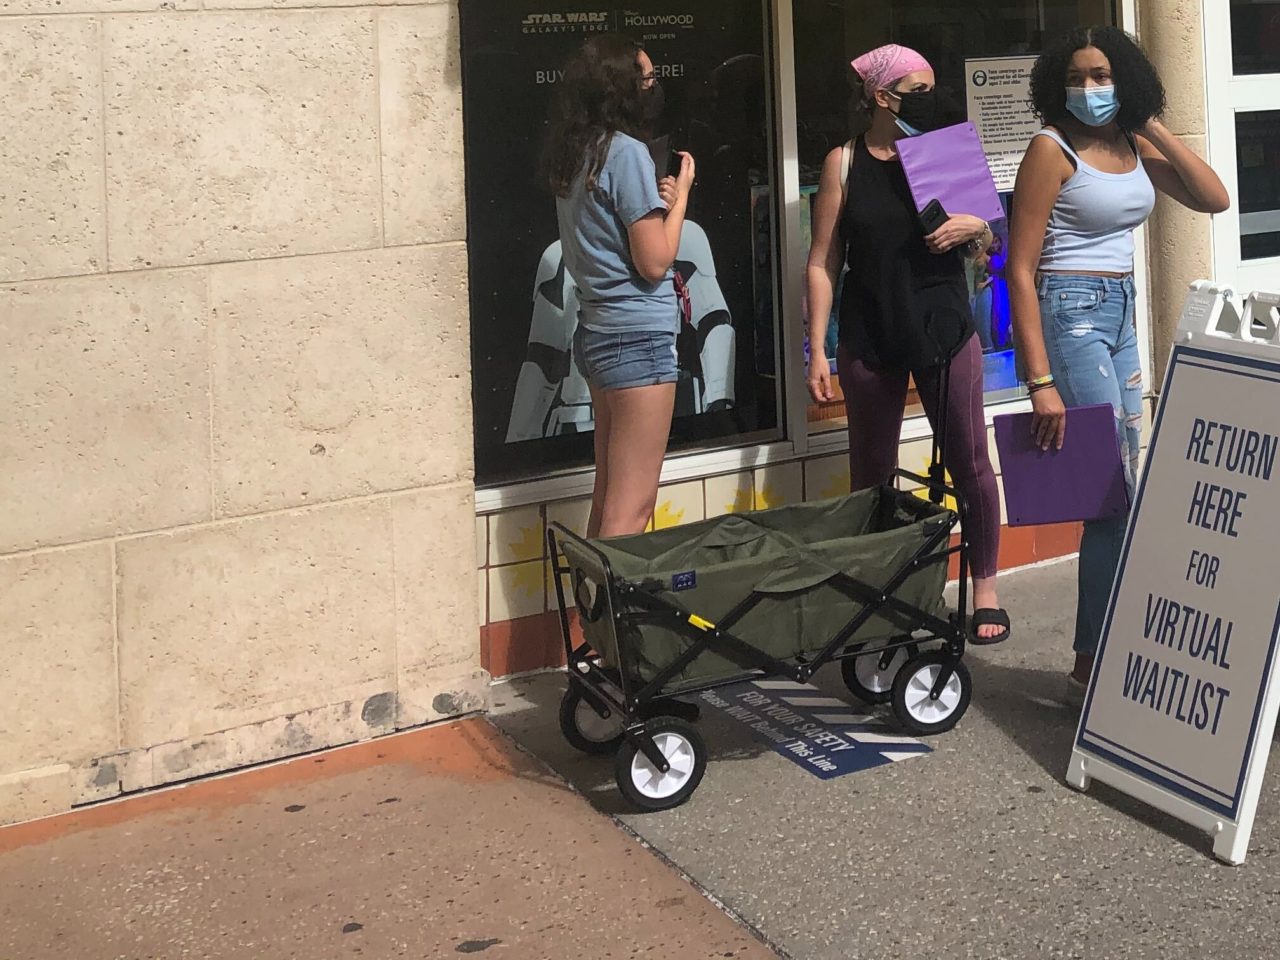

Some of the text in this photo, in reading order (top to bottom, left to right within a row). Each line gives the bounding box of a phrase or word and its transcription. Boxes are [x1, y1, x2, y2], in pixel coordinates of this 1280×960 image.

[522, 12, 608, 25] STAR WARS
[522, 24, 609, 34] GALAXY'S EDGE
[625, 14, 694, 26] HOLLYWOOD
[536, 63, 685, 84] BUY ERE!
[1186, 418, 1278, 481] RETURN
[1187, 481, 1247, 538] HERE
[1185, 550, 1220, 589] FOR
[1143, 593, 1233, 670] VIRTUAL
[1122, 652, 1230, 735] WAITLIST
[736, 691, 855, 752] FOR YOUR SAFETY
[785, 741, 813, 758] This
[807, 754, 838, 772] Line
